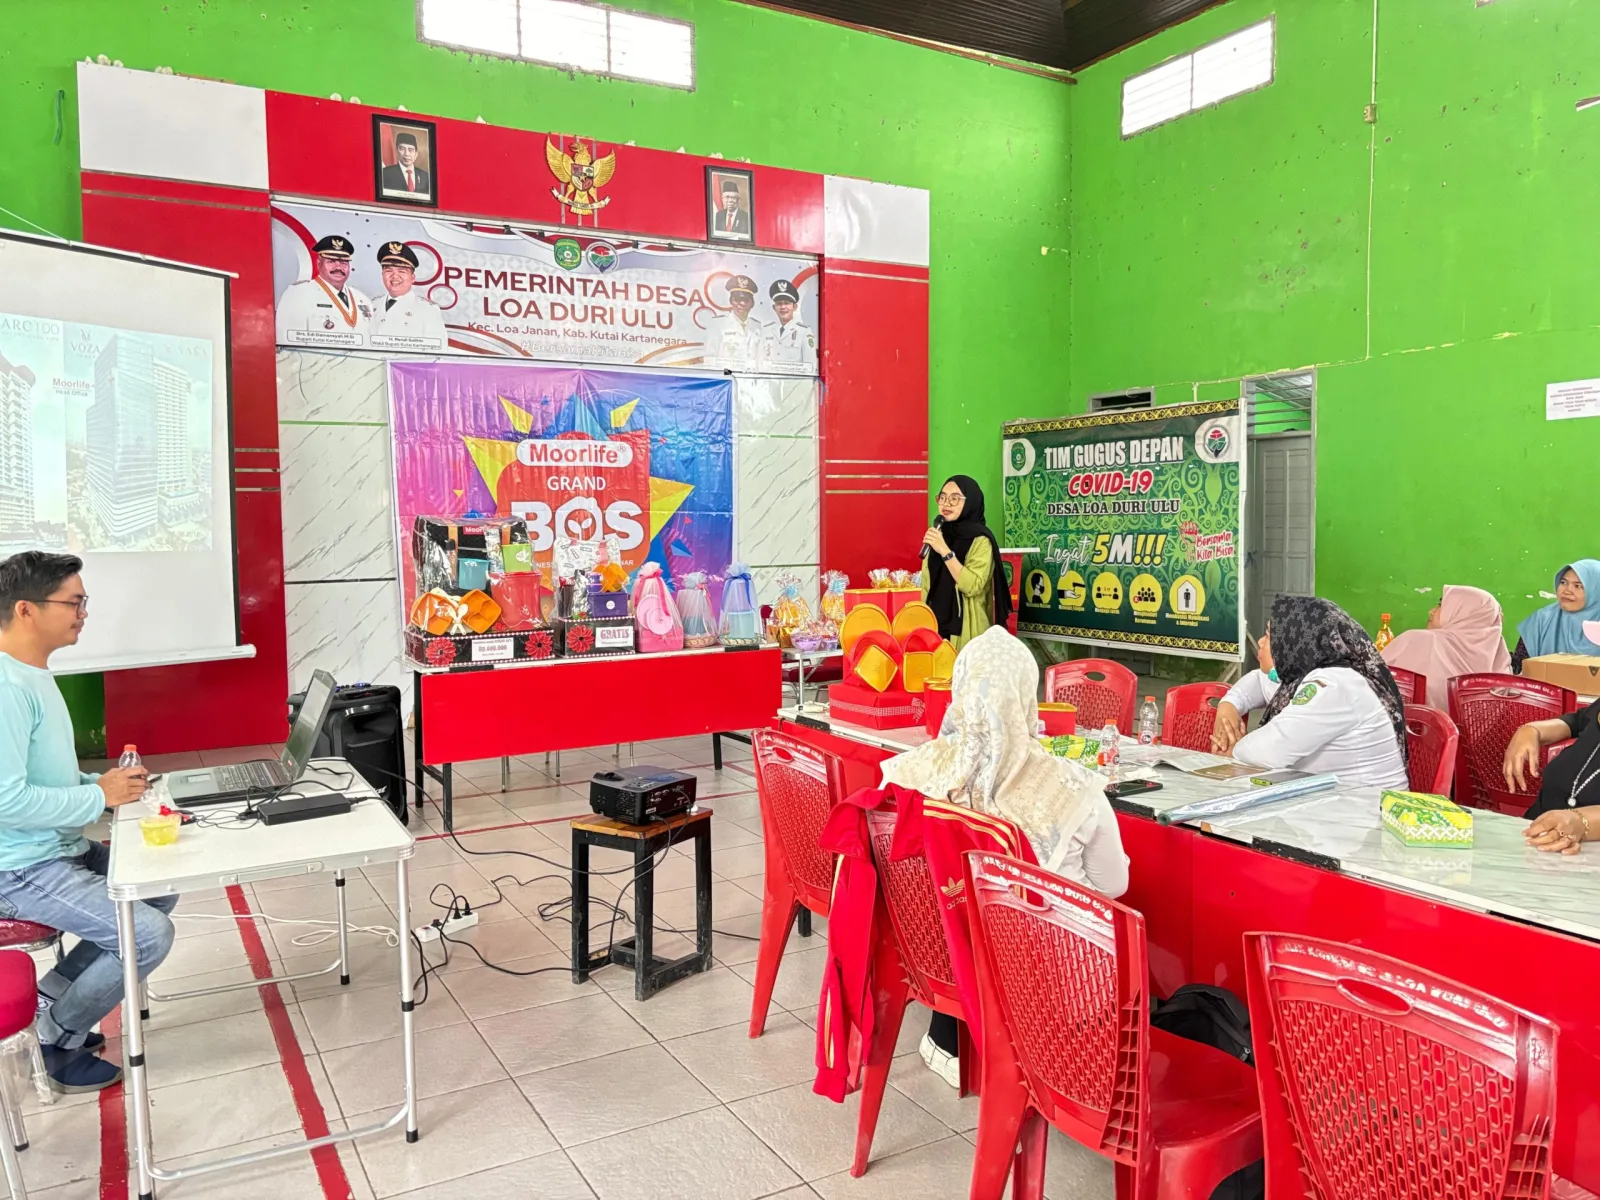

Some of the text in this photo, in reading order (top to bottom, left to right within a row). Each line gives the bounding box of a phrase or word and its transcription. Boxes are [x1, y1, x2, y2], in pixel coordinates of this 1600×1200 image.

[444, 266, 705, 307] PEMERINTAH DESA
[483, 296, 673, 330] LOA DURI ULU
[468, 322, 687, 346] Kec. Loa Janan, Kab. Kutai Kartanegara
[70, 342, 101, 354] VOZA
[52, 378, 90, 389] Moorlife
[529, 443, 619, 464] Moorlife
[1044, 437, 1183, 470] TIM GUGUS DEPAN
[547, 476, 607, 491] GRAND
[1068, 469, 1154, 496] COVID-19
[1047, 500, 1180, 515] DESA LOA DURI ULU
[1196, 531, 1232, 548] Bersama
[1044, 533, 1168, 576] Ingat 5M!!!
[600, 629, 630, 639] GRATIS
